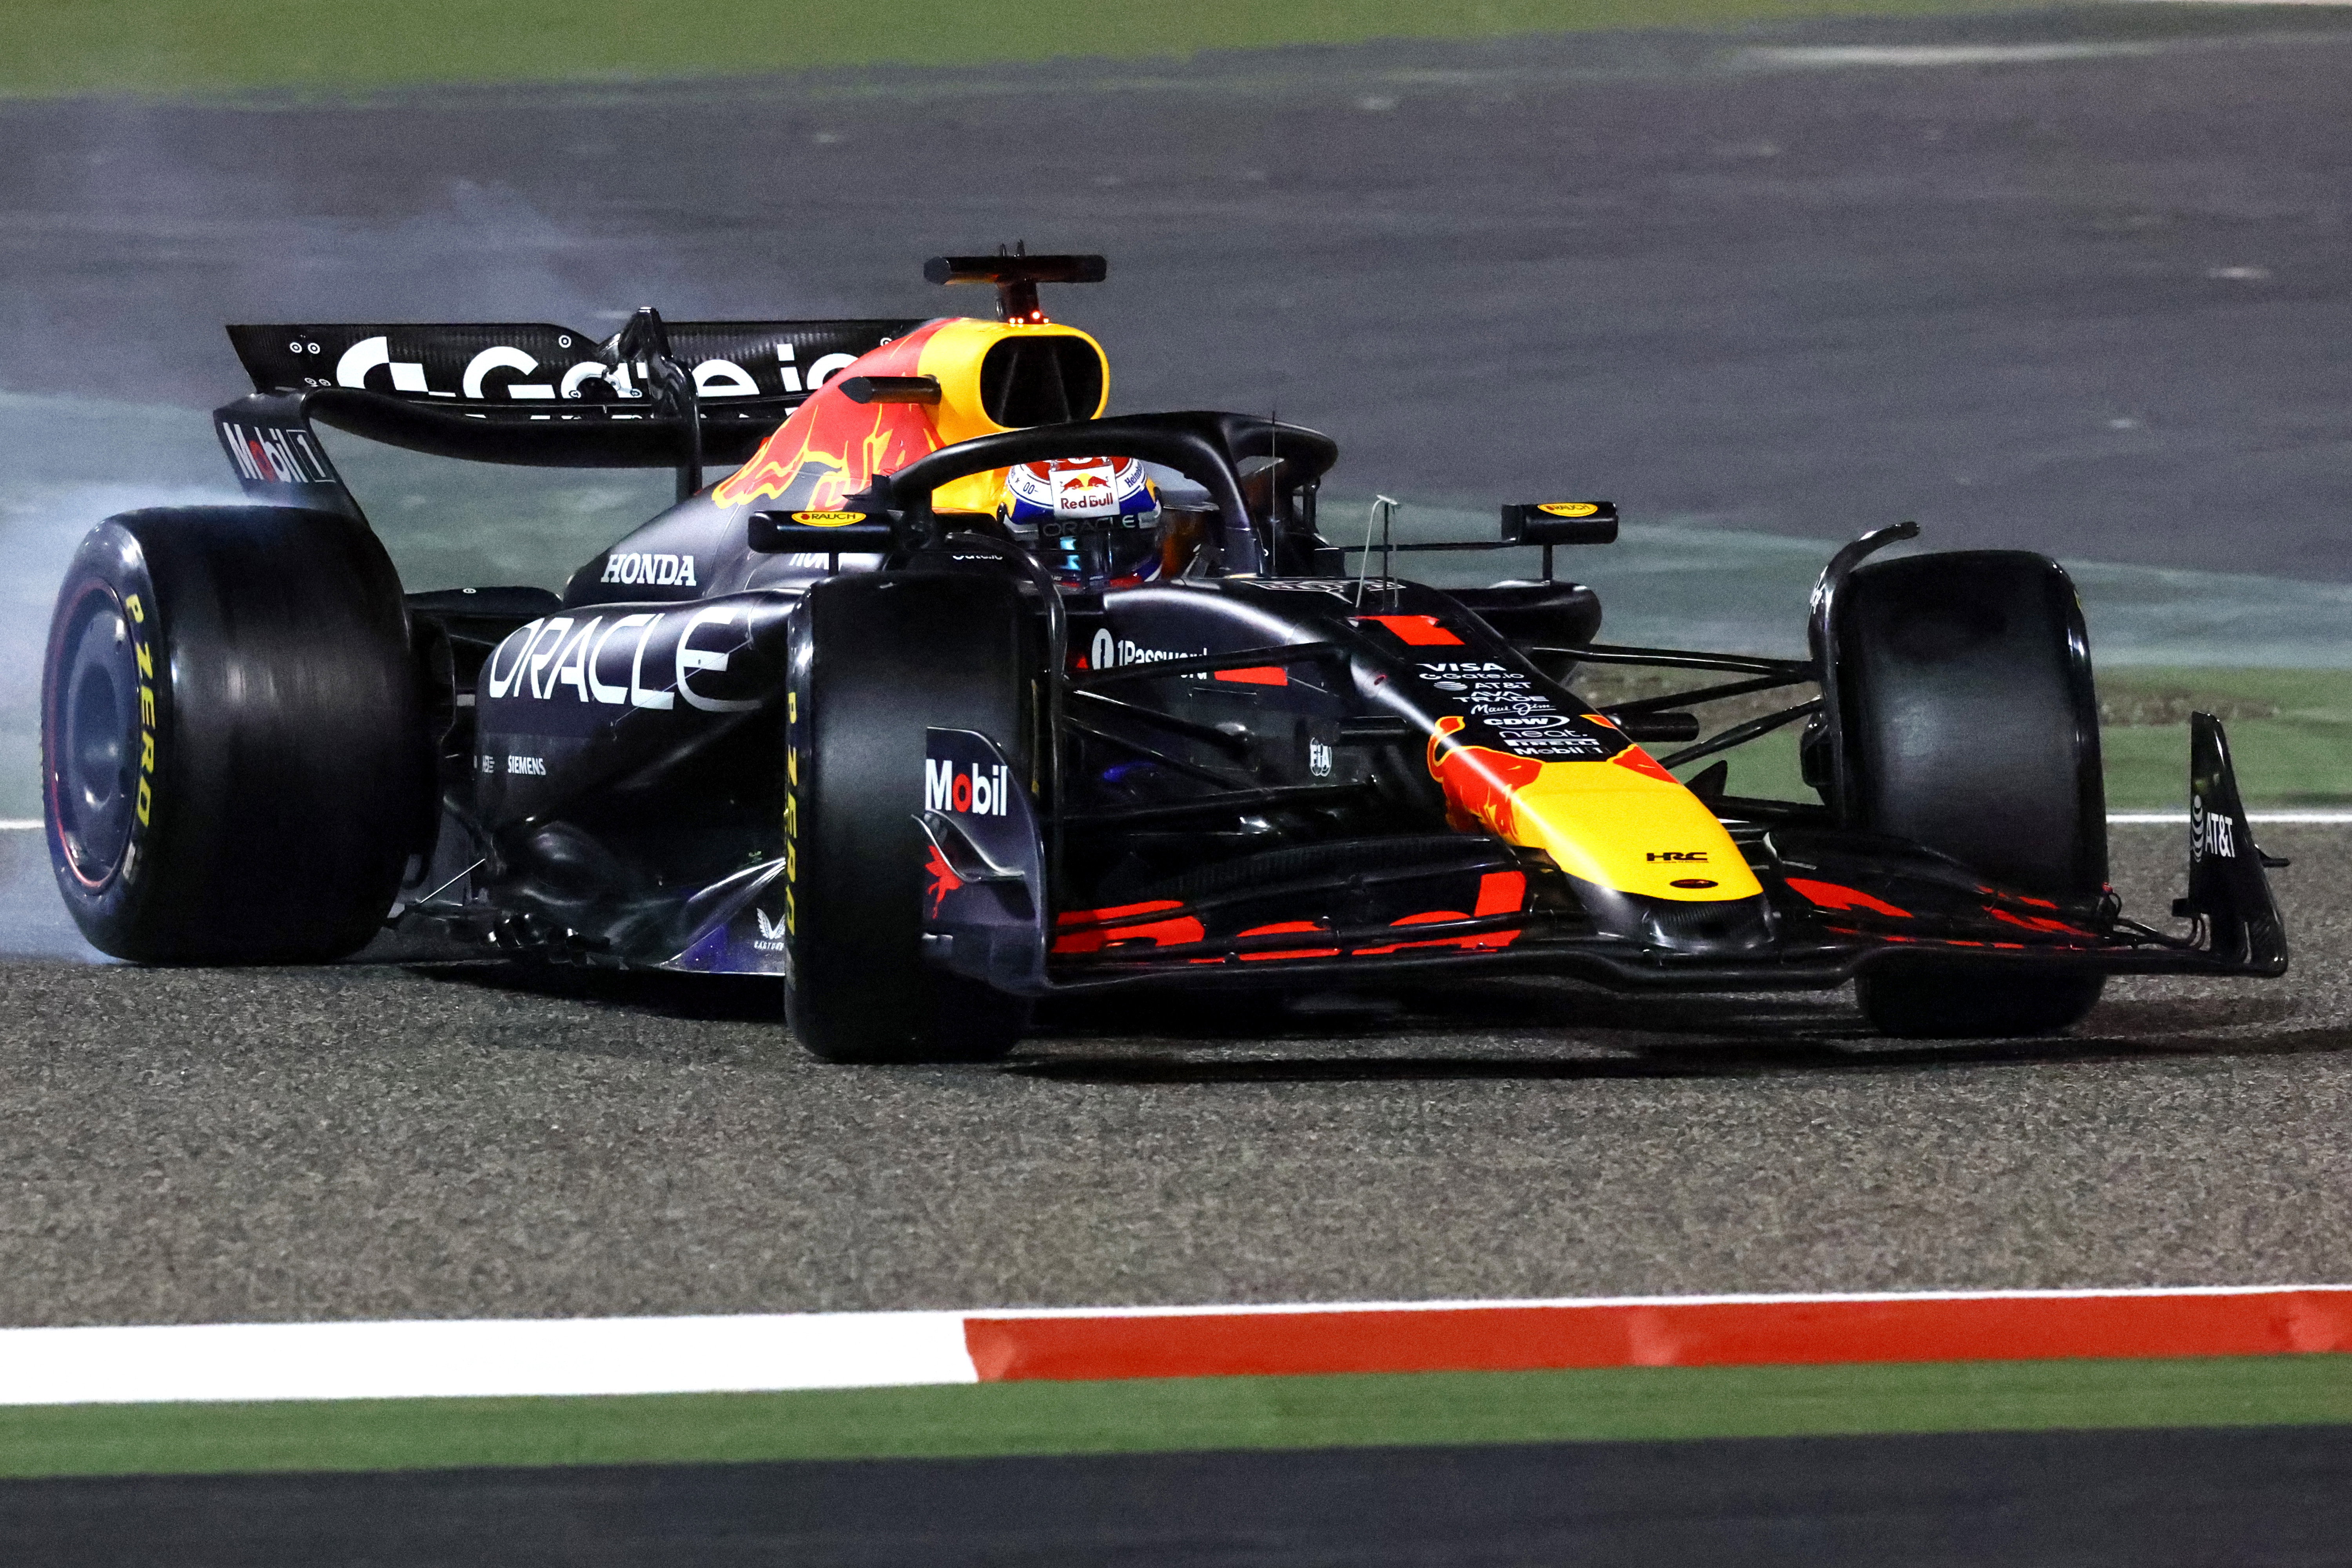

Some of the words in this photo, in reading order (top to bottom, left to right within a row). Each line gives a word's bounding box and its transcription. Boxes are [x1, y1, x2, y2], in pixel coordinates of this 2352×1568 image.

[223, 422, 309, 484] Mobil
[1061, 495, 1086, 510] Red
[1089, 492, 1113, 508] Bull
[601, 553, 697, 586] HONDA
[489, 606, 764, 713] ORACLE
[1415, 662, 1506, 671] VISA
[125, 593, 145, 623] P
[135, 641, 156, 828] ZERO
[1499, 729, 1588, 738] neat.
[1503, 738, 1600, 746] PIRELLI
[508, 755, 546, 776] SIEMENS
[926, 759, 1007, 816] Mobil
[2205, 812, 2235, 858] AT&T
[1646, 852, 1708, 862] HRC
